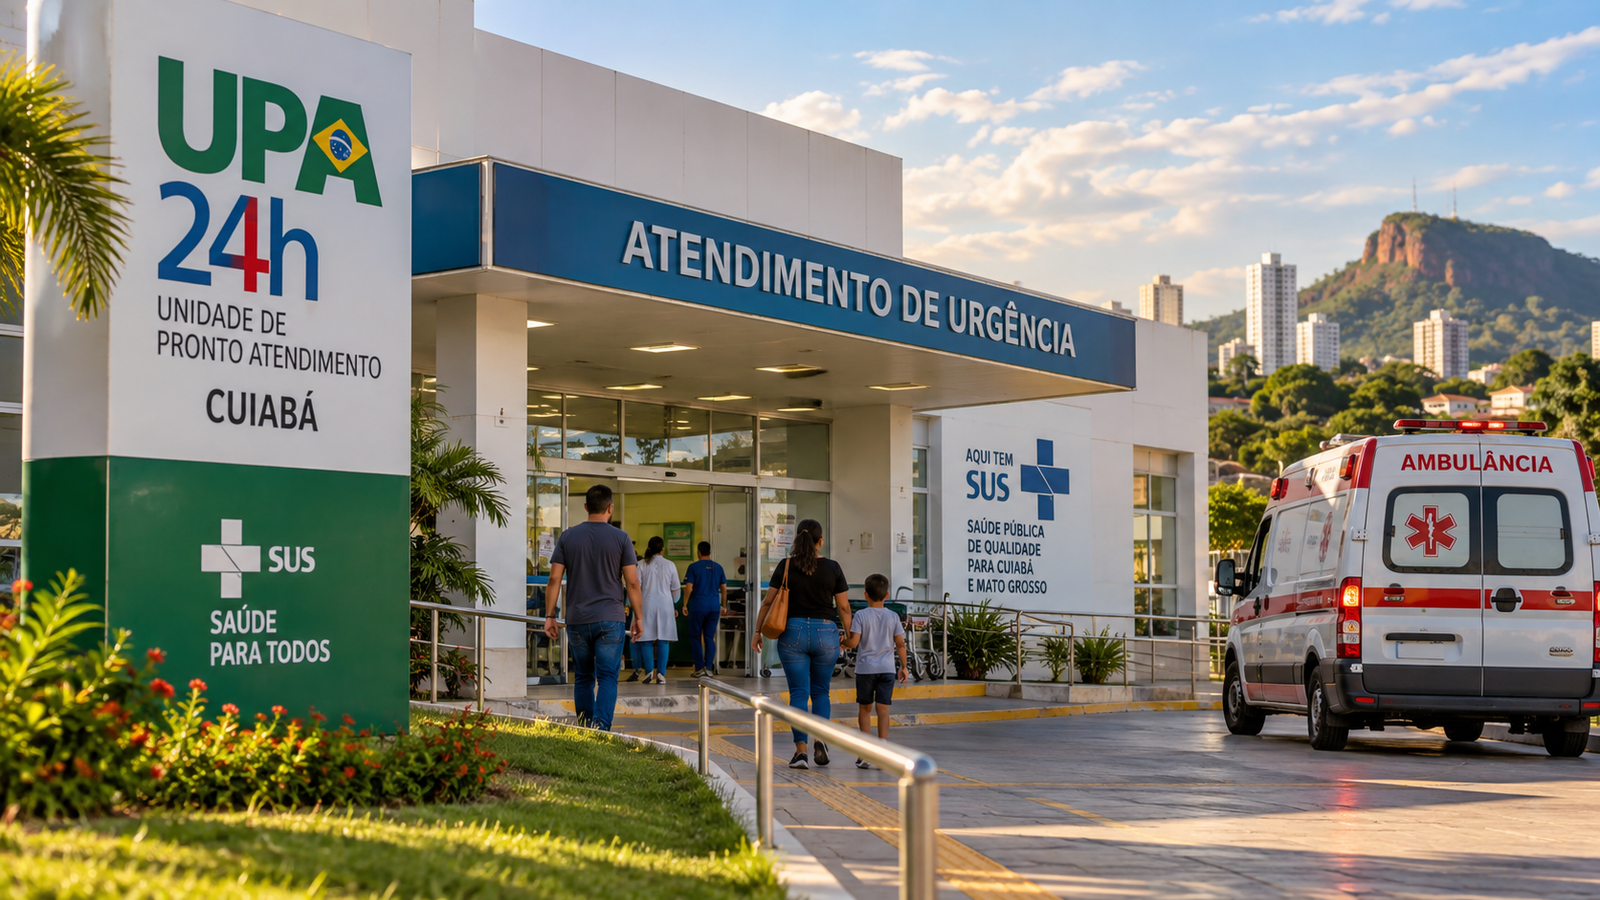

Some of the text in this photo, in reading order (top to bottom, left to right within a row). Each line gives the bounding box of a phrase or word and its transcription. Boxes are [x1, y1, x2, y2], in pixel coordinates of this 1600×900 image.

[158, 55, 383, 207] UPA
[157, 181, 319, 301] 24h
[622, 220, 1077, 358] ATENDIMENTO DE URGÊNCIA
[157, 295, 287, 336] UNIDADE DE
[157, 329, 382, 380] PRONTO ATENDIMENTO
[205, 388, 319, 432] CUIABÁ
[965, 448, 1014, 467] AQUI TEM
[1400, 450, 1554, 474] AMBULÂNCIA
[966, 469, 1010, 502] SUS
[967, 517, 1045, 539] SAÚDE PÚBLICA
[268, 545, 316, 573] SUS
[967, 538, 1042, 557] DE QUALIDADE
[967, 558, 1035, 576] PARA CUIABÁ
[967, 578, 1048, 595] E MATO GROSSO
[209, 604, 278, 635] SAÚDE
[209, 639, 331, 667] PARA TODOS
